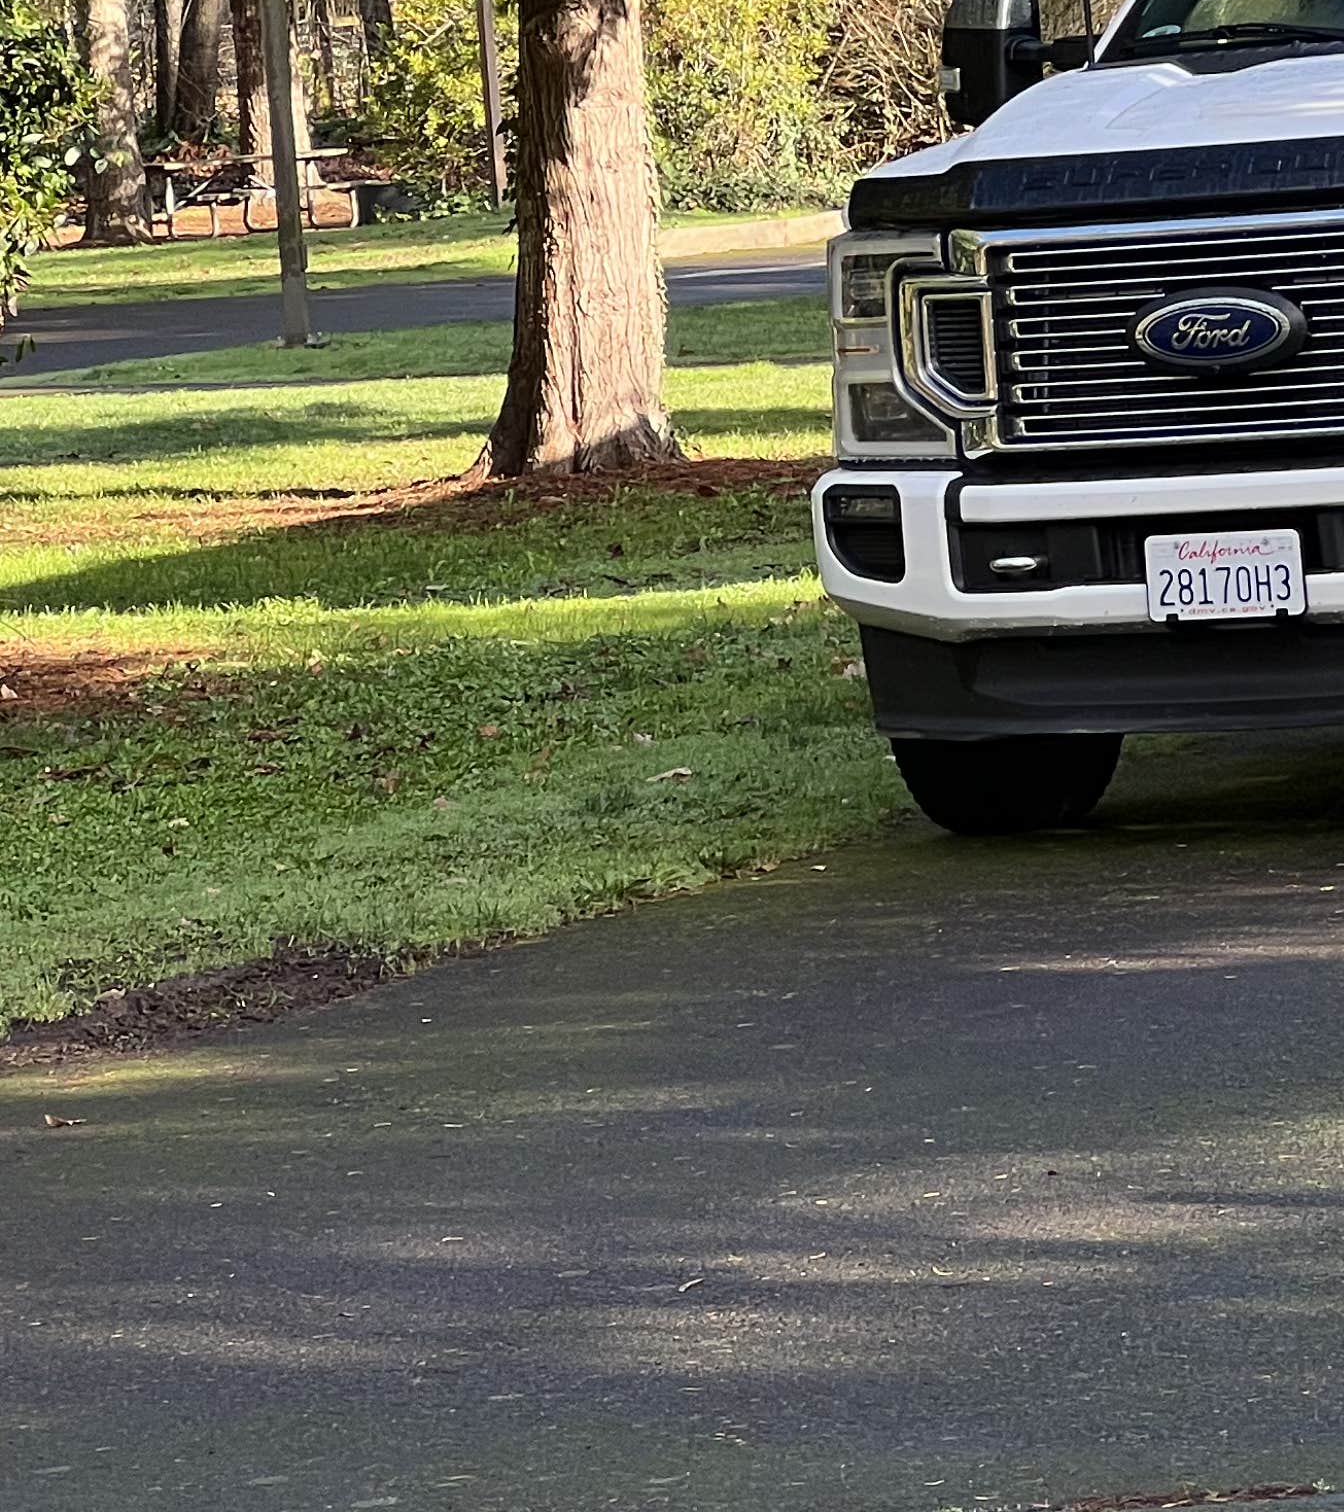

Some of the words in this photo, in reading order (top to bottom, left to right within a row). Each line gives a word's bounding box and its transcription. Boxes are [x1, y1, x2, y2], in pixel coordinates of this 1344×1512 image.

[1171, 313, 1251, 350] Ford
[1178, 540, 1273, 564] California
[1159, 564, 1291, 607] 28170H3
